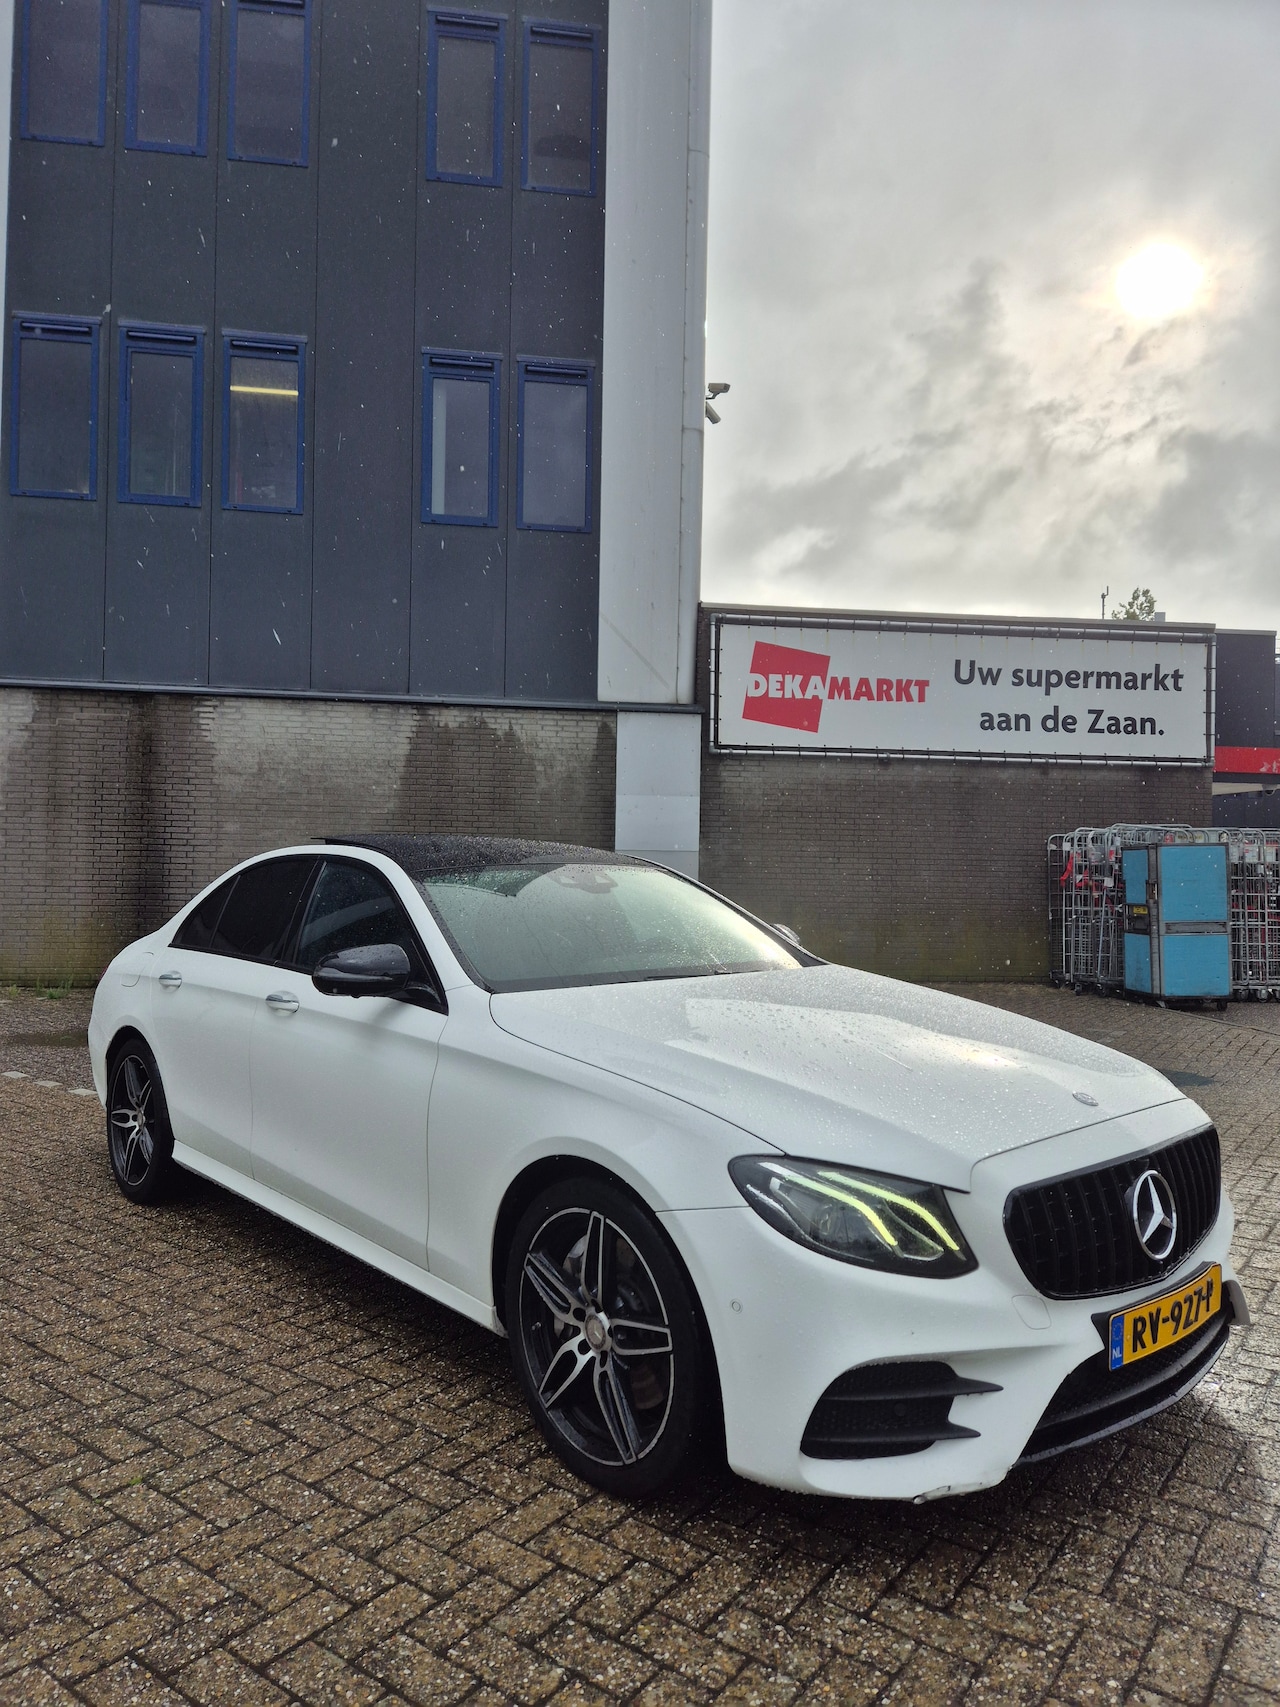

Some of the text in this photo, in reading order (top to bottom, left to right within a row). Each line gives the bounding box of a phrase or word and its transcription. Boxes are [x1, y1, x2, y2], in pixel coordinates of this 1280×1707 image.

[746, 673, 930, 703] DEKAMARKT
[954, 659, 1184, 696] Uw supermarkt
[979, 705, 1165, 736] aan de Zaan.
[1112, 1346, 1123, 1360] NL
